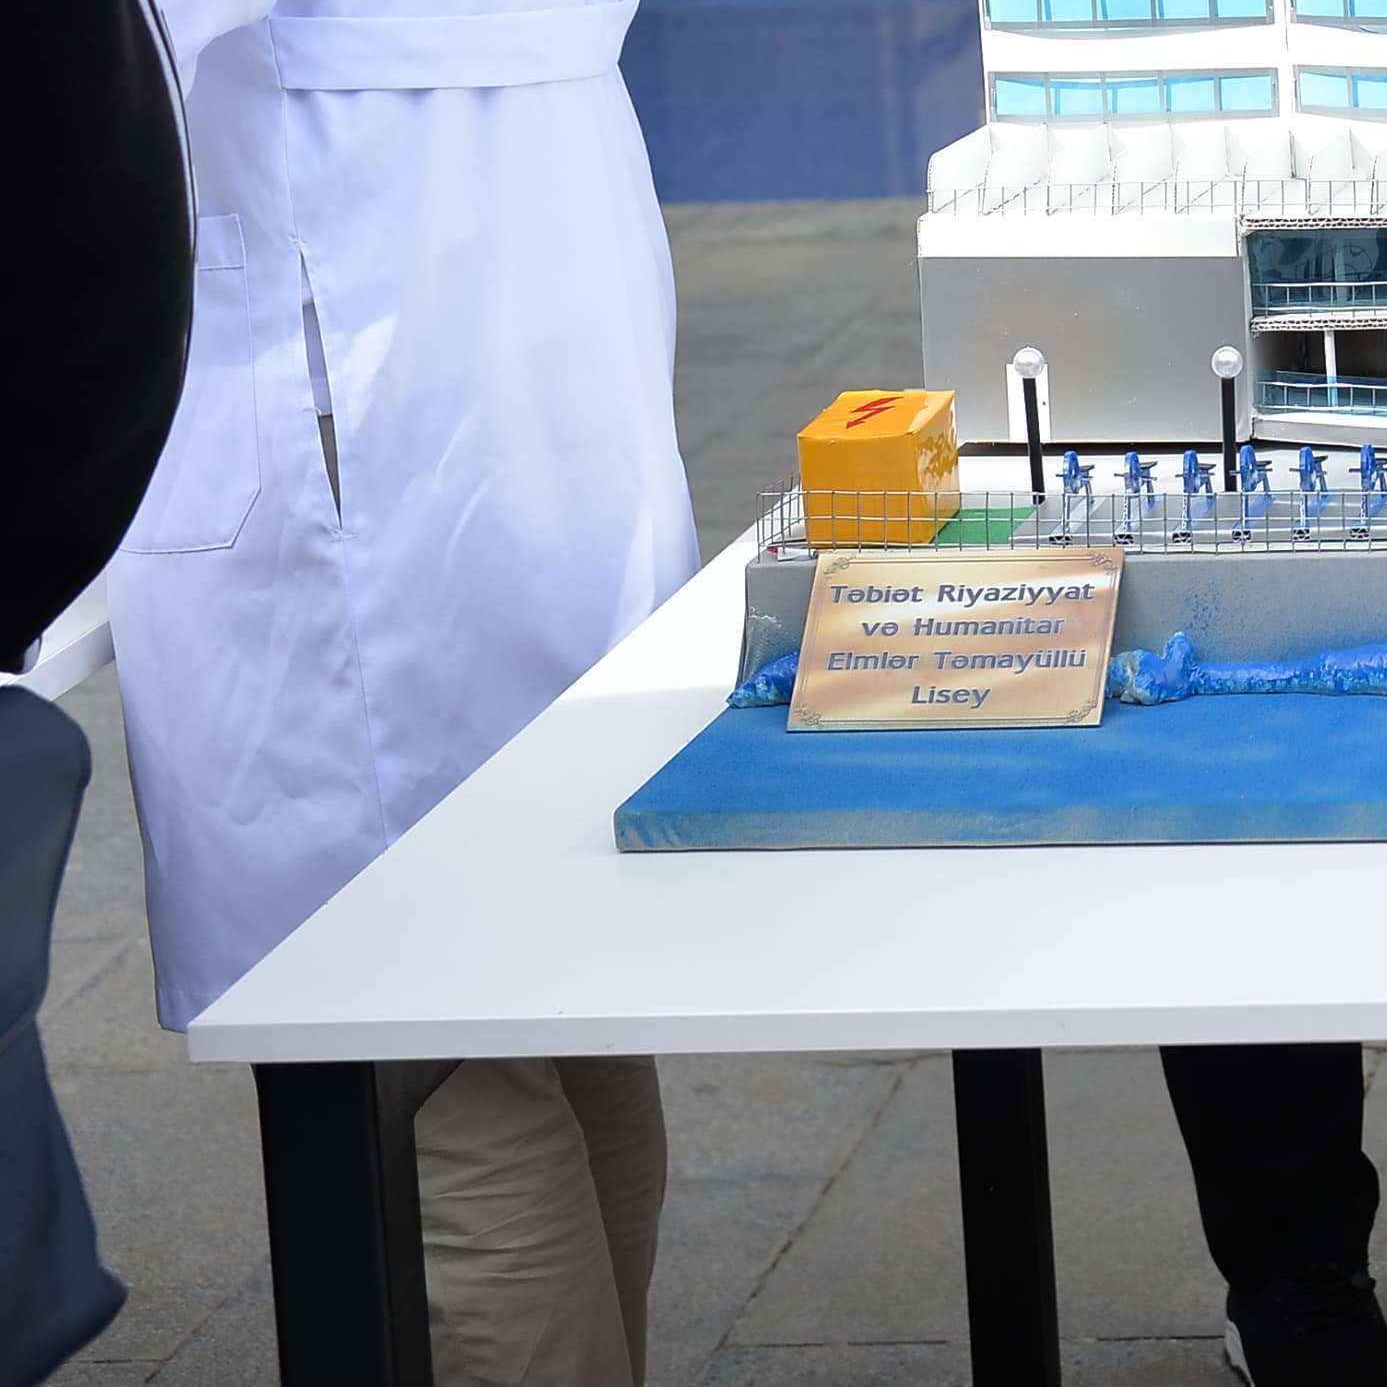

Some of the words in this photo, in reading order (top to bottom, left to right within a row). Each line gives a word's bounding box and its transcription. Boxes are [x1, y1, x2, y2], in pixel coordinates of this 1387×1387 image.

[829, 584, 924, 604] Təbiət
[937, 582, 1096, 608] Riyaziyyat
[861, 621, 899, 637] və
[913, 618, 1065, 637] Humanitar
[827, 651, 920, 671] Elmlər
[934, 649, 1088, 675] Təmayüllü
[911, 685, 992, 709] Lisey
